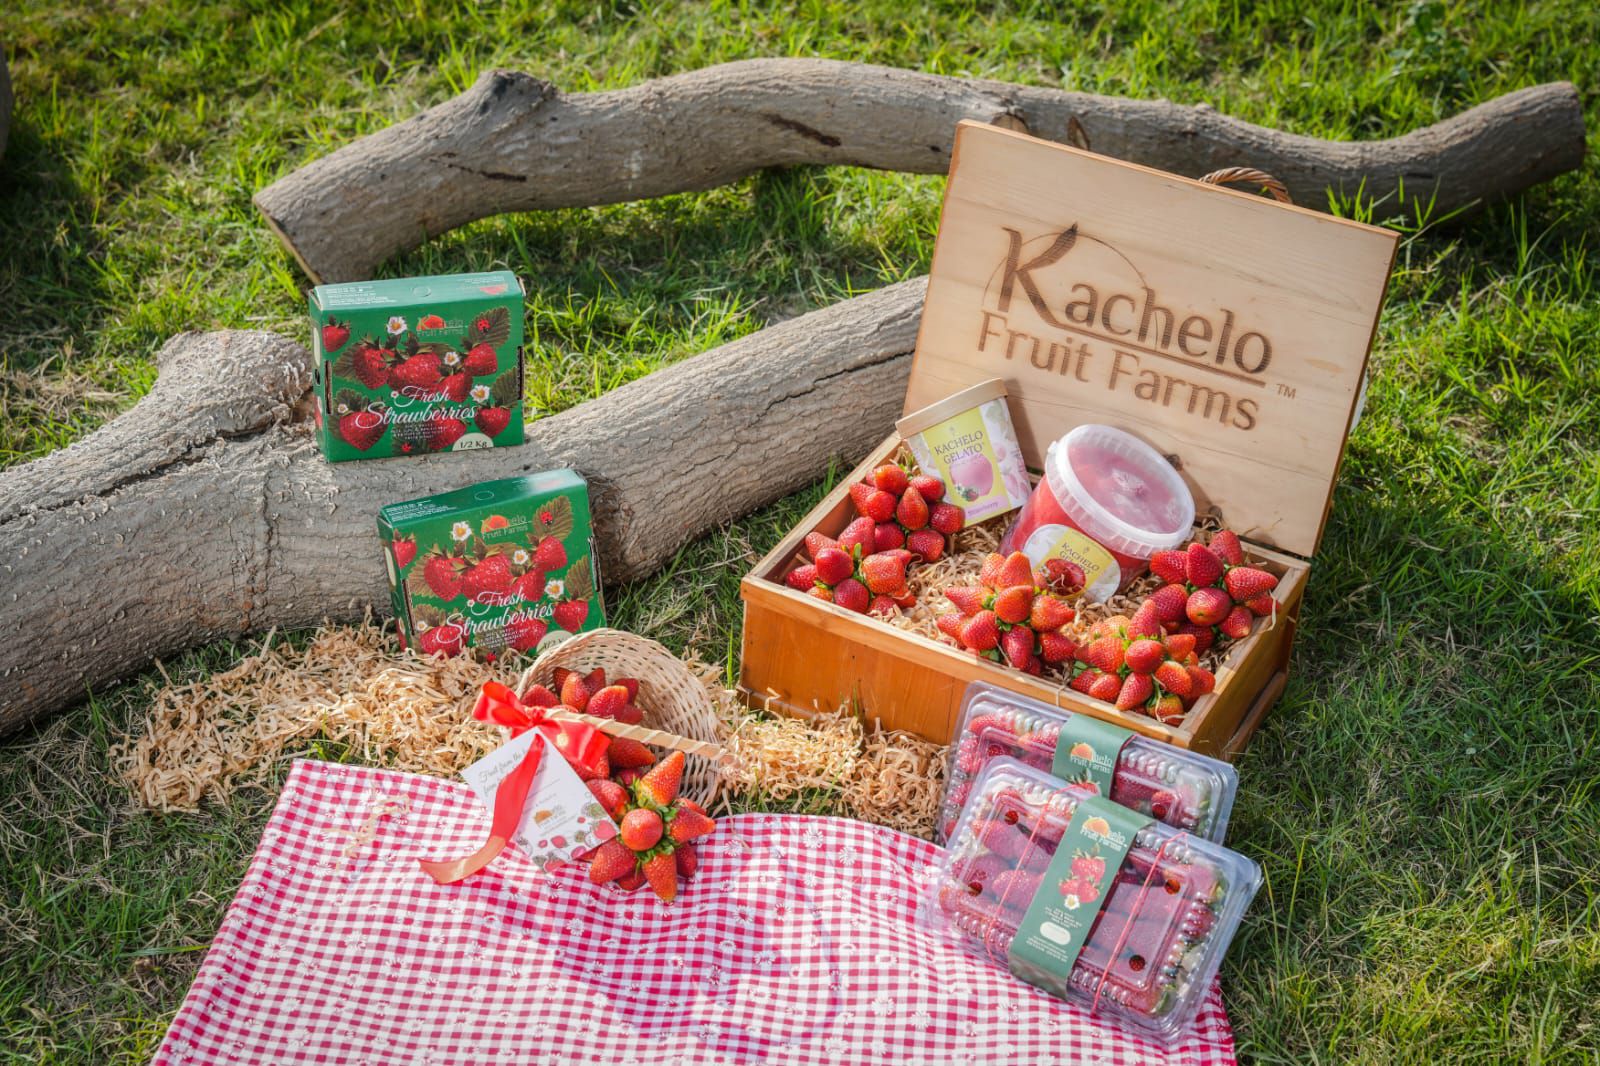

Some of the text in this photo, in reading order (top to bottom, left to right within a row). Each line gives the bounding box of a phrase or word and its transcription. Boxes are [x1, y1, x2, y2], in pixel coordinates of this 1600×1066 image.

[998, 222, 1273, 375] Kachelo
[416, 314, 464, 330] Kelo
[977, 310, 1093, 383] Fruit
[1108, 349, 1260, 431] Farms
[394, 384, 450, 408] Fresh
[355, 401, 478, 429] Strawberries
[934, 430, 984, 456] KACHELO
[943, 443, 983, 465] GELATO
[480, 514, 527, 532] Kelo
[1061, 542, 1100, 572] KACHELO
[470, 585, 526, 616] Fresh
[435, 602, 554, 644] Strawberries
